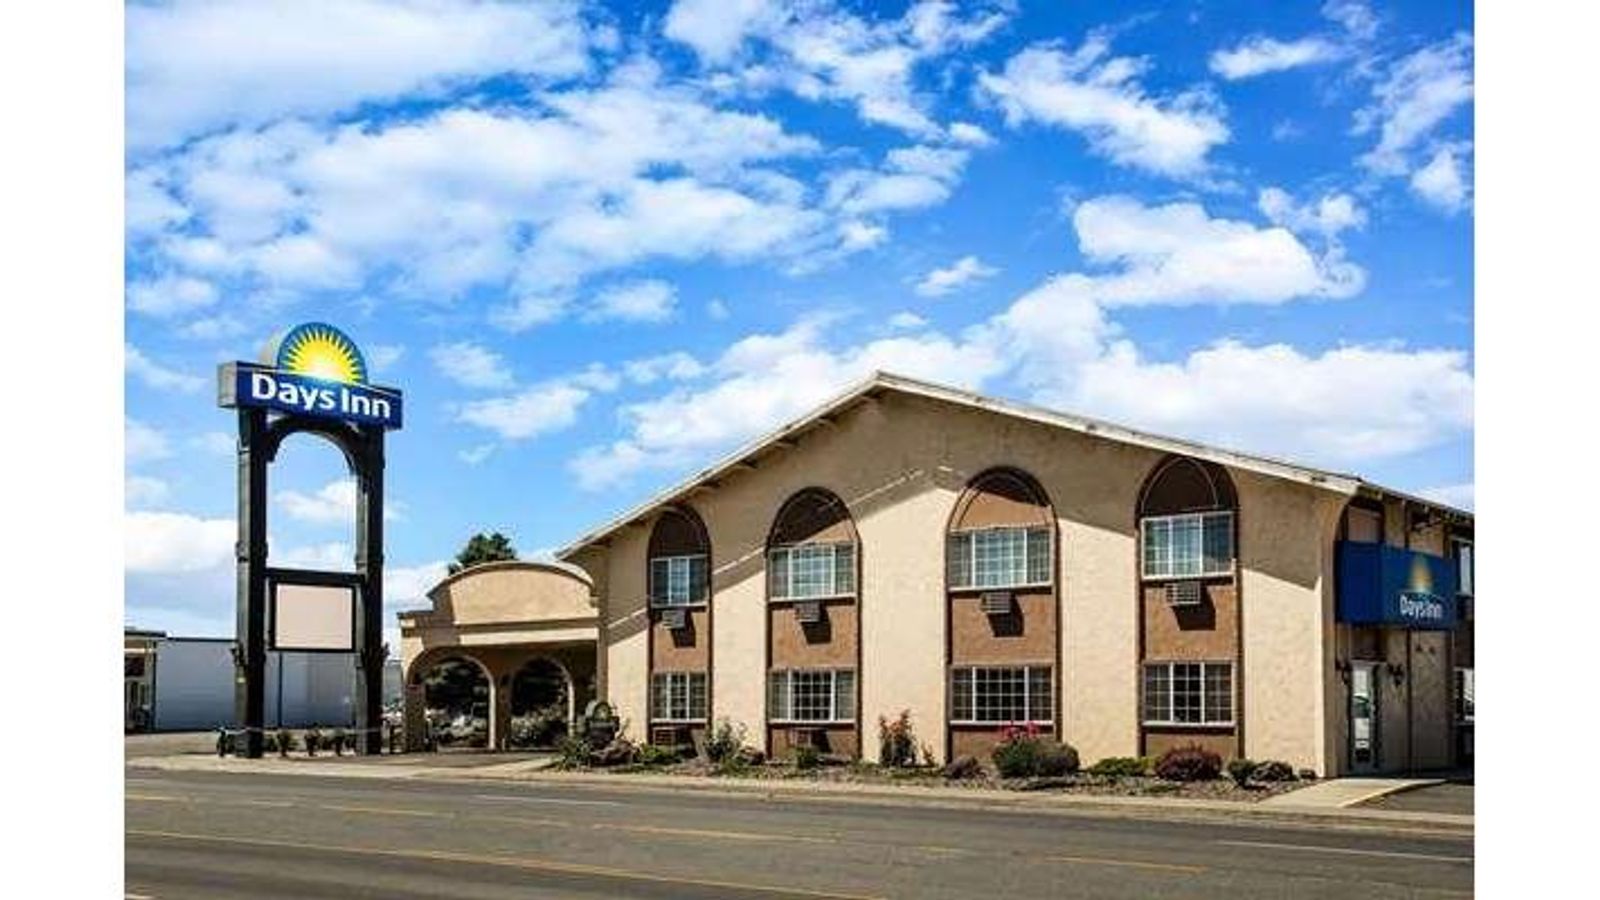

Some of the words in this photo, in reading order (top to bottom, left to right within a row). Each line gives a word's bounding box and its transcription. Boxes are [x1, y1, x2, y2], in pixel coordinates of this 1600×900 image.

[251, 373, 335, 411] Days
[341, 388, 391, 419] Inn
[1400, 594, 1426, 620] Days
